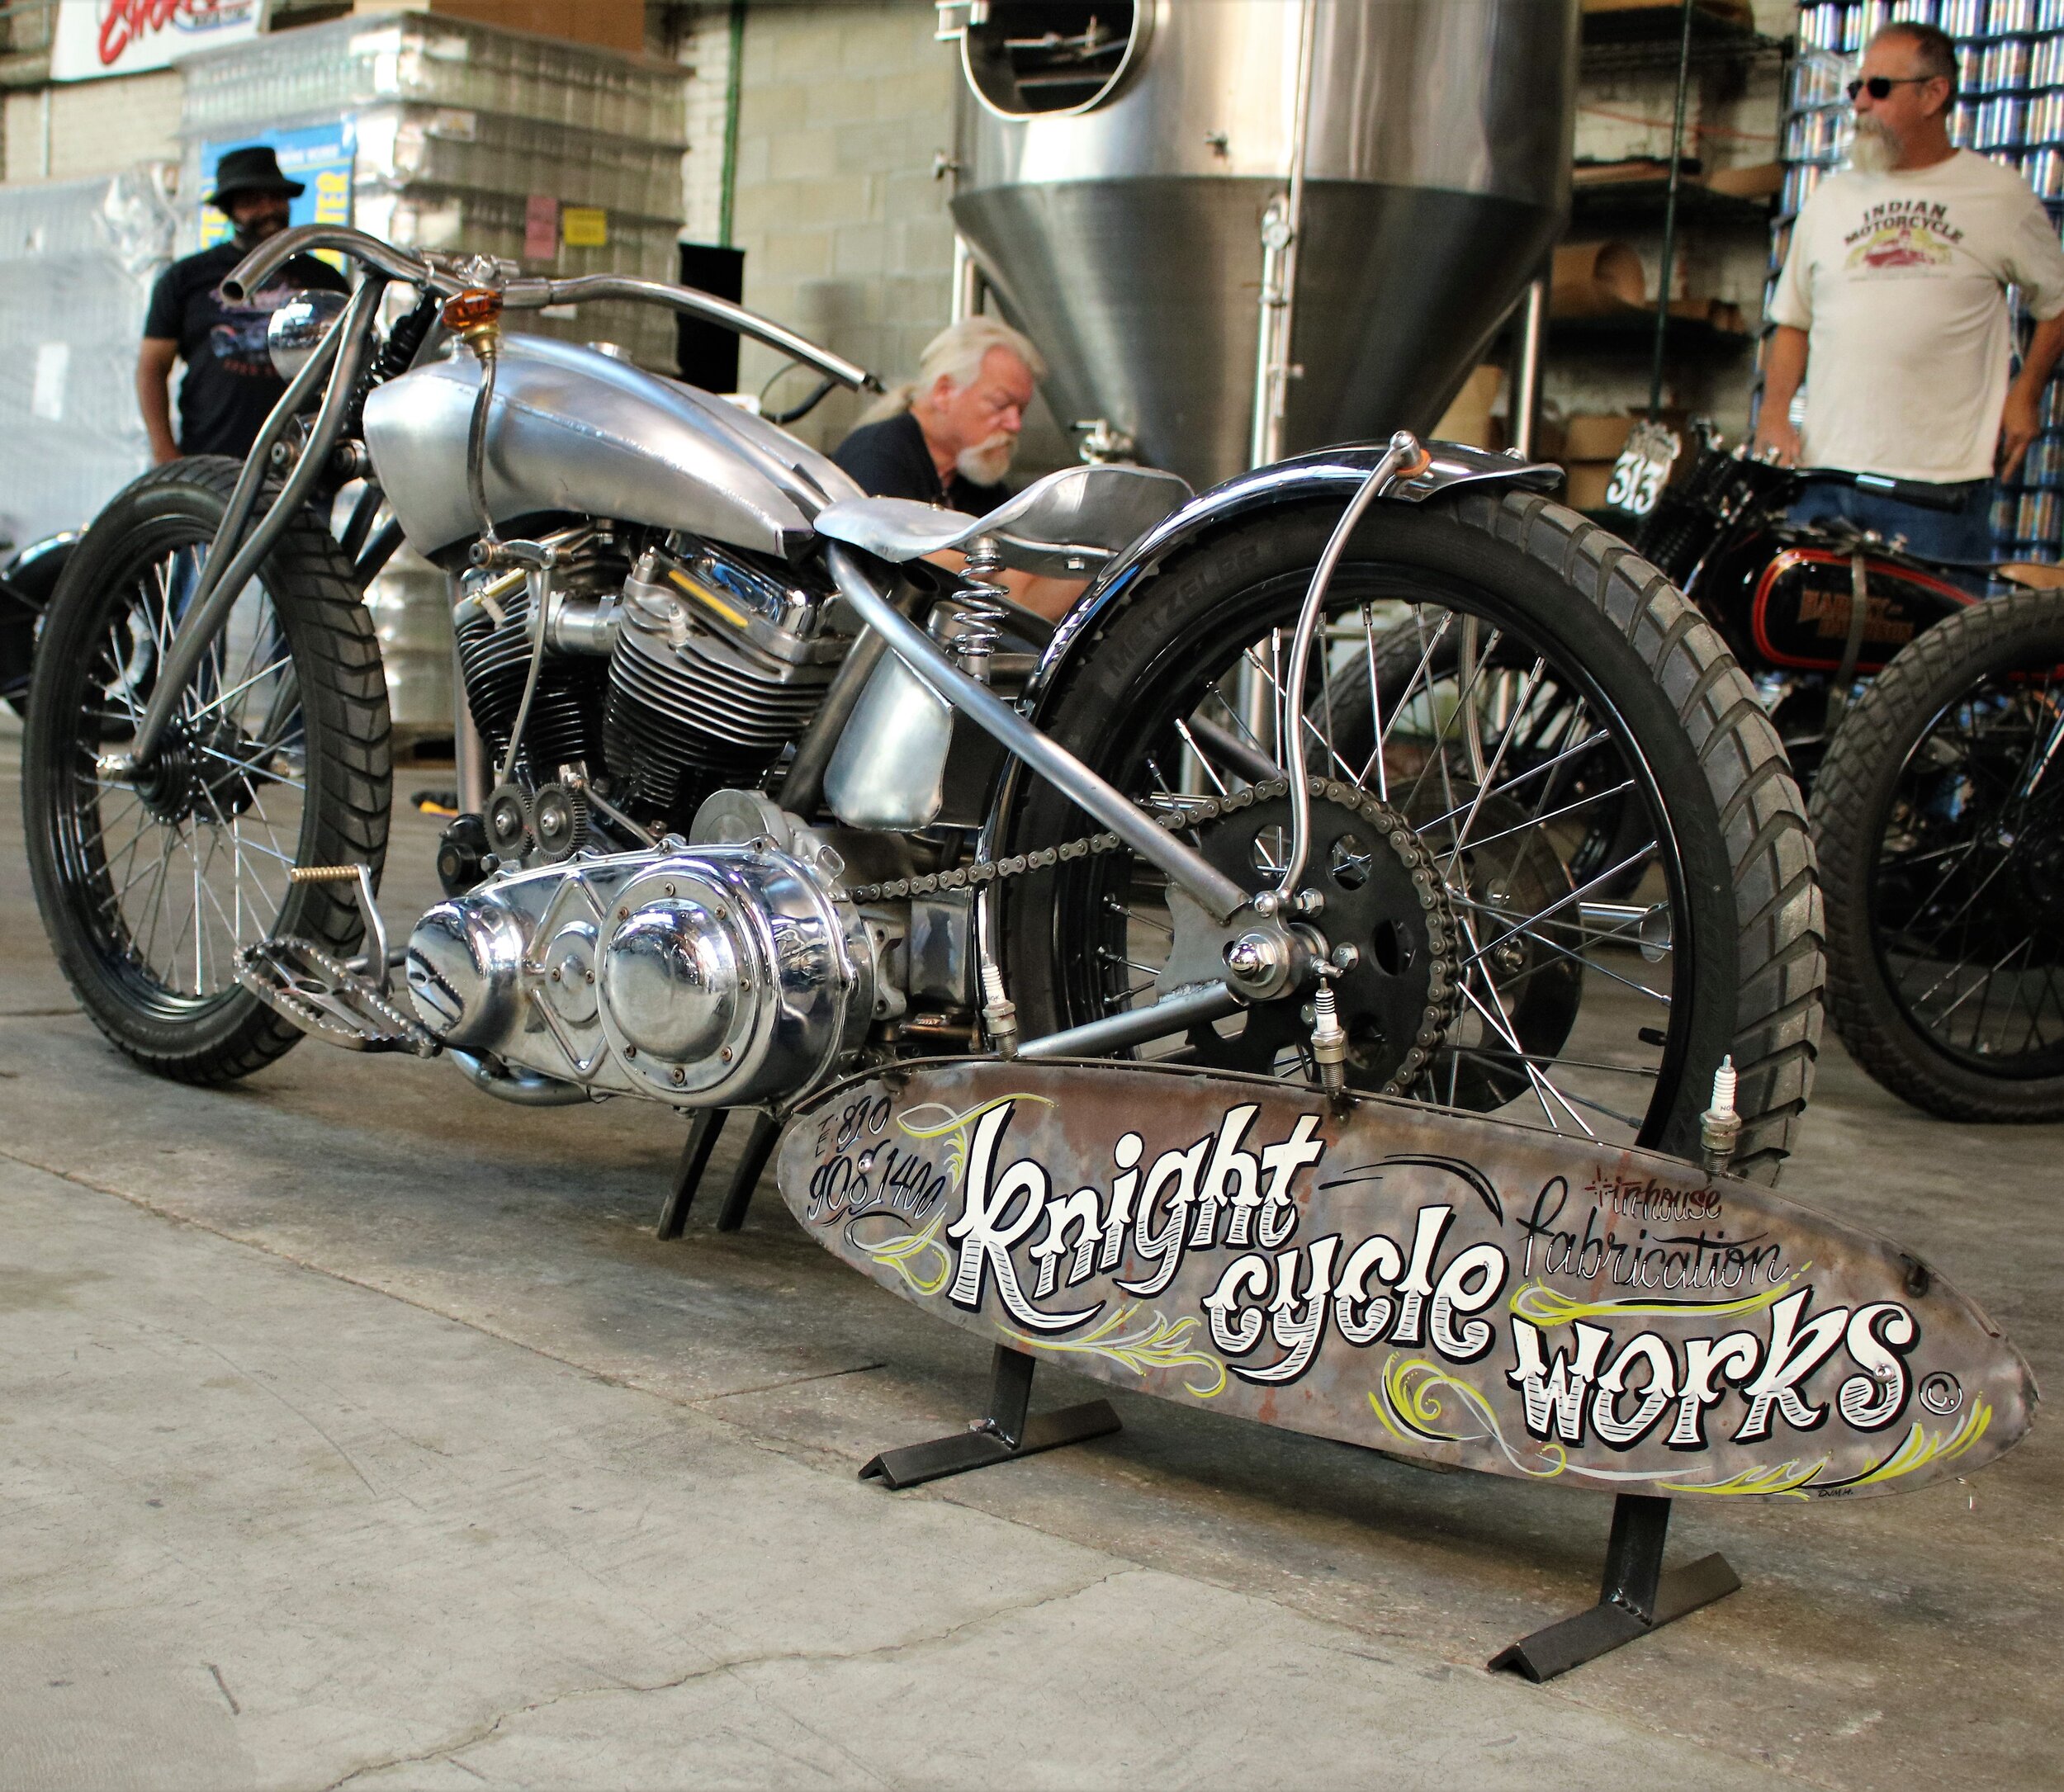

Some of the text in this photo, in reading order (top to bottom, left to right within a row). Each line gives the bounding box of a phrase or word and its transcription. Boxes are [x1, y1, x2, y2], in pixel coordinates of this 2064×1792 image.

[1844, 215, 1964, 246] MOTORCYCLE
[1863, 200, 1948, 222] INDIAN
[1606, 451, 1670, 515] 313
[1200, 1205, 1509, 1387] cycle
